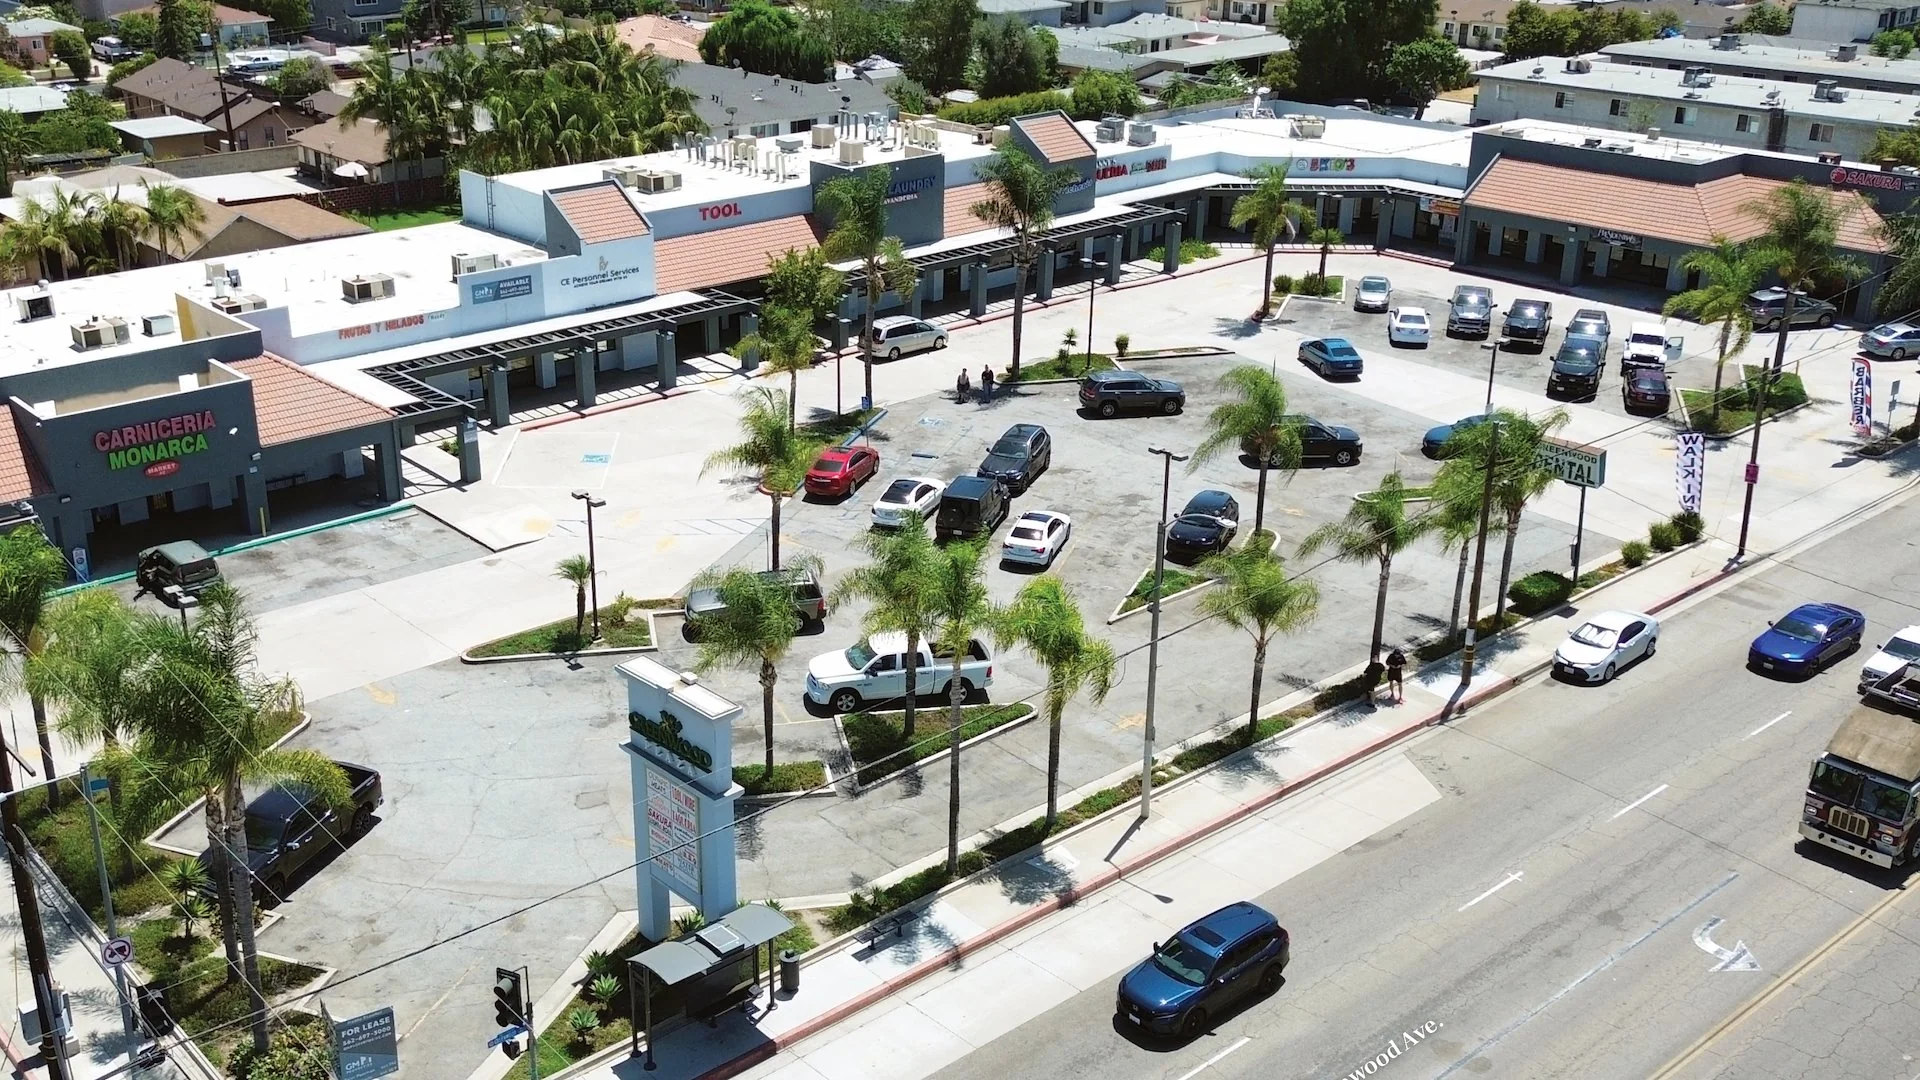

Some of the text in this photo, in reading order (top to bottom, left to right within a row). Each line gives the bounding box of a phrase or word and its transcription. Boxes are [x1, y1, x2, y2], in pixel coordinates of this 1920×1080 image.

[887, 175, 937, 195] LAUNDRY
[1847, 171, 1902, 190] SAKURA
[883, 193, 919, 205] AVANDERIA
[699, 203, 742, 221] TOOL
[500, 278, 529, 289] AVAILABLE
[560, 266, 640, 287] CE Personnel Services
[338, 323, 372, 340] FRUTAS
[375, 321, 382, 333] Y
[385, 314, 425, 332] HELADOS
[95, 409, 217, 452] CARNICERIA
[108, 433, 209, 471] MONARCA
[1540, 442, 1598, 465] REENWOOD
[147, 462, 177, 474] MARKET
[648, 807, 672, 829] SAKURA
[341, 1026, 361, 1039] FOR
[362, 1016, 391, 1032] LEASE
